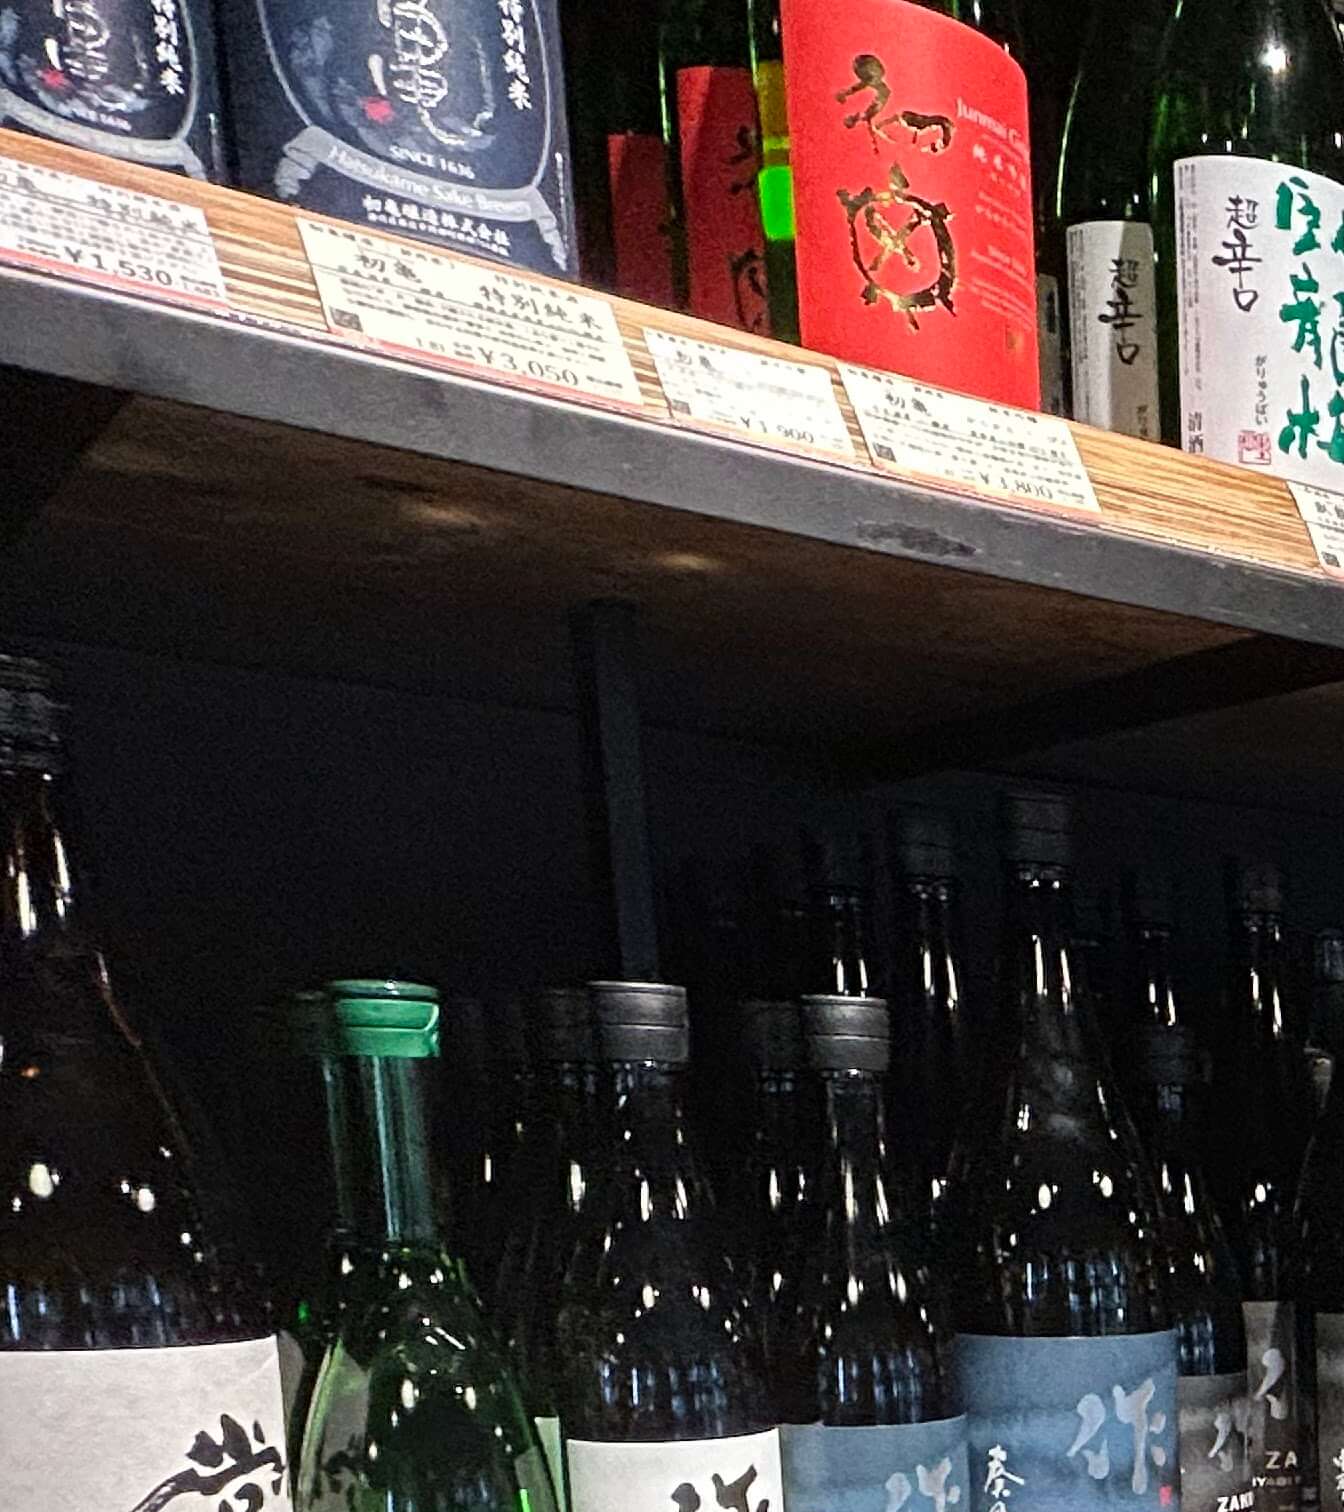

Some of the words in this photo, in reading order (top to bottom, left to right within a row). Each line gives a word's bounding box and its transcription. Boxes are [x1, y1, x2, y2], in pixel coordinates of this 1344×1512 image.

[389, 145, 435, 168] SINCE
[64, 246, 173, 286] ¥1,530
[1211, 194, 1263, 312] 超辛口
[479, 284, 604, 330] 特別純米
[1098, 257, 1143, 365] 超辛口
[482, 345, 579, 386] ¥3,050
[1066, 1377, 1168, 1495] 作
